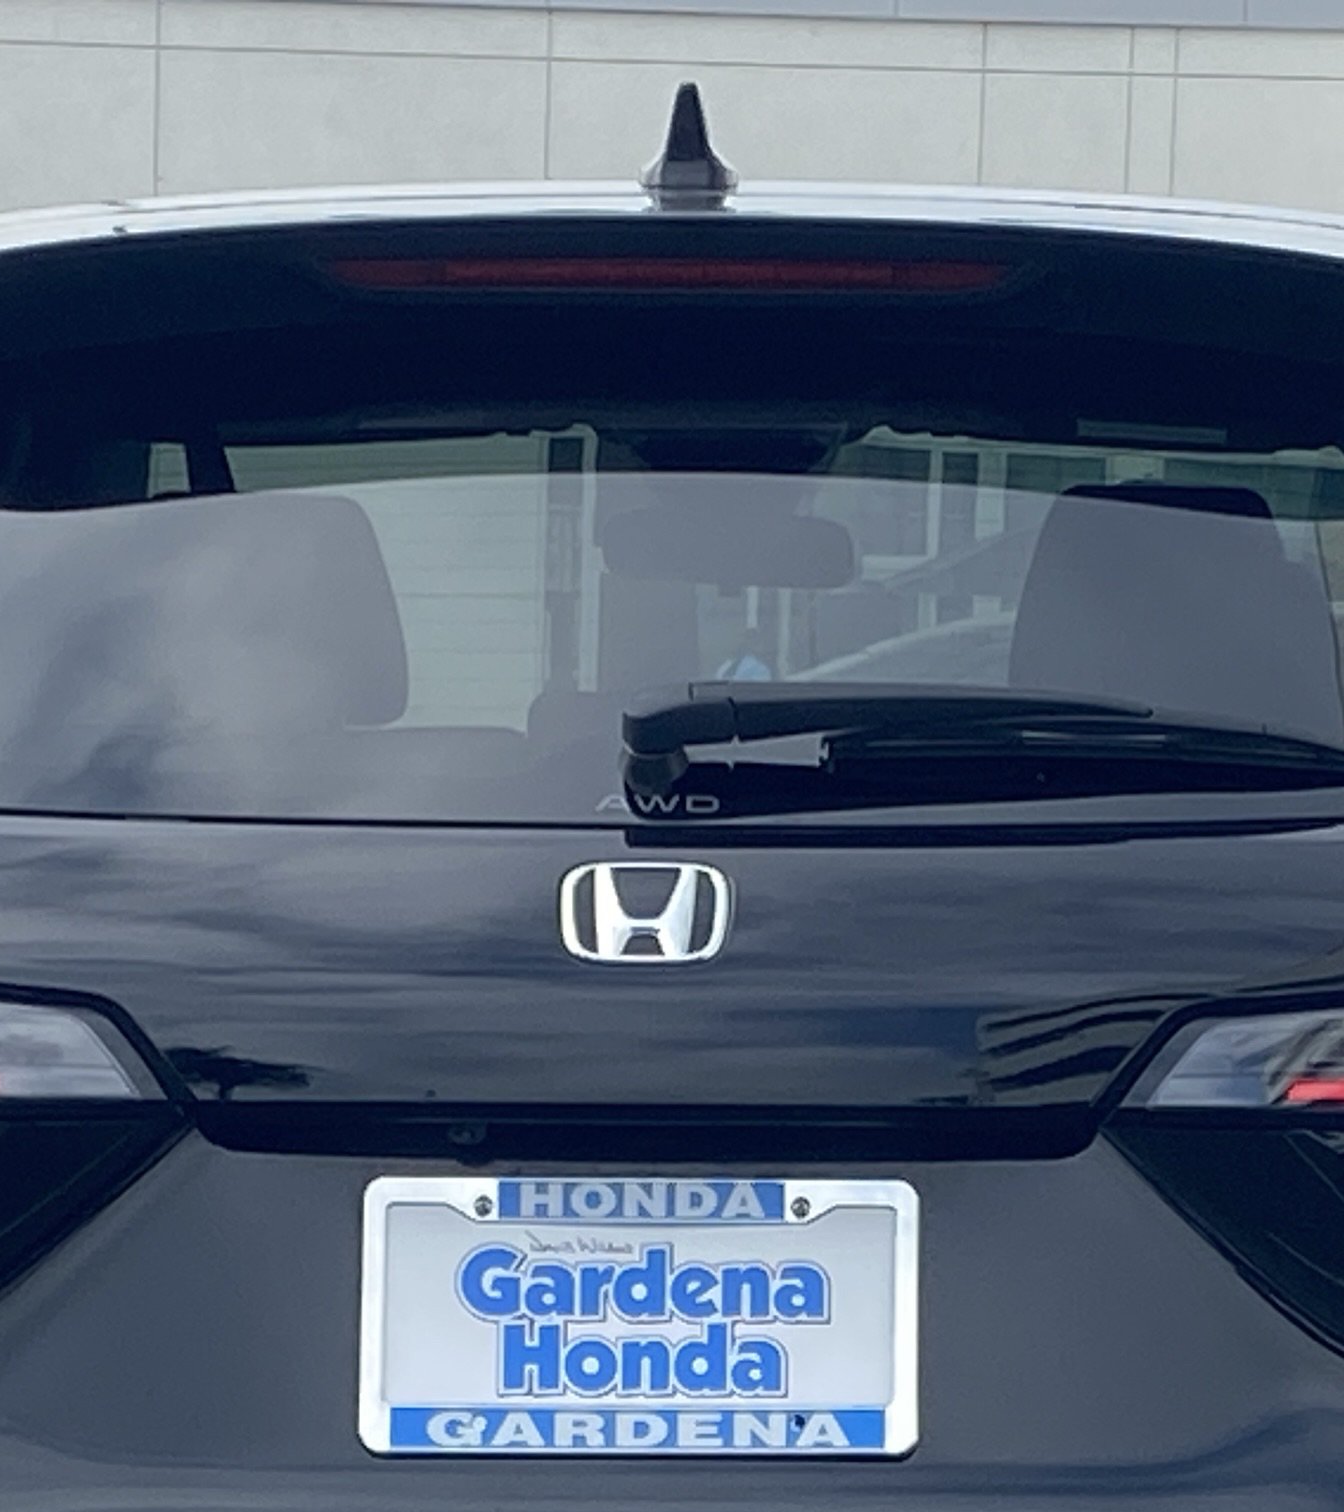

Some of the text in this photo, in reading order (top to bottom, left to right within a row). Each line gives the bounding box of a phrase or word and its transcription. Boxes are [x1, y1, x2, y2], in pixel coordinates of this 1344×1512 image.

[594, 793, 720, 814] AWD
[519, 1182, 766, 1219] HONDA
[459, 1247, 827, 1319] Gardena
[501, 1325, 783, 1392] Honda
[425, 1411, 851, 1448] GARDENA
